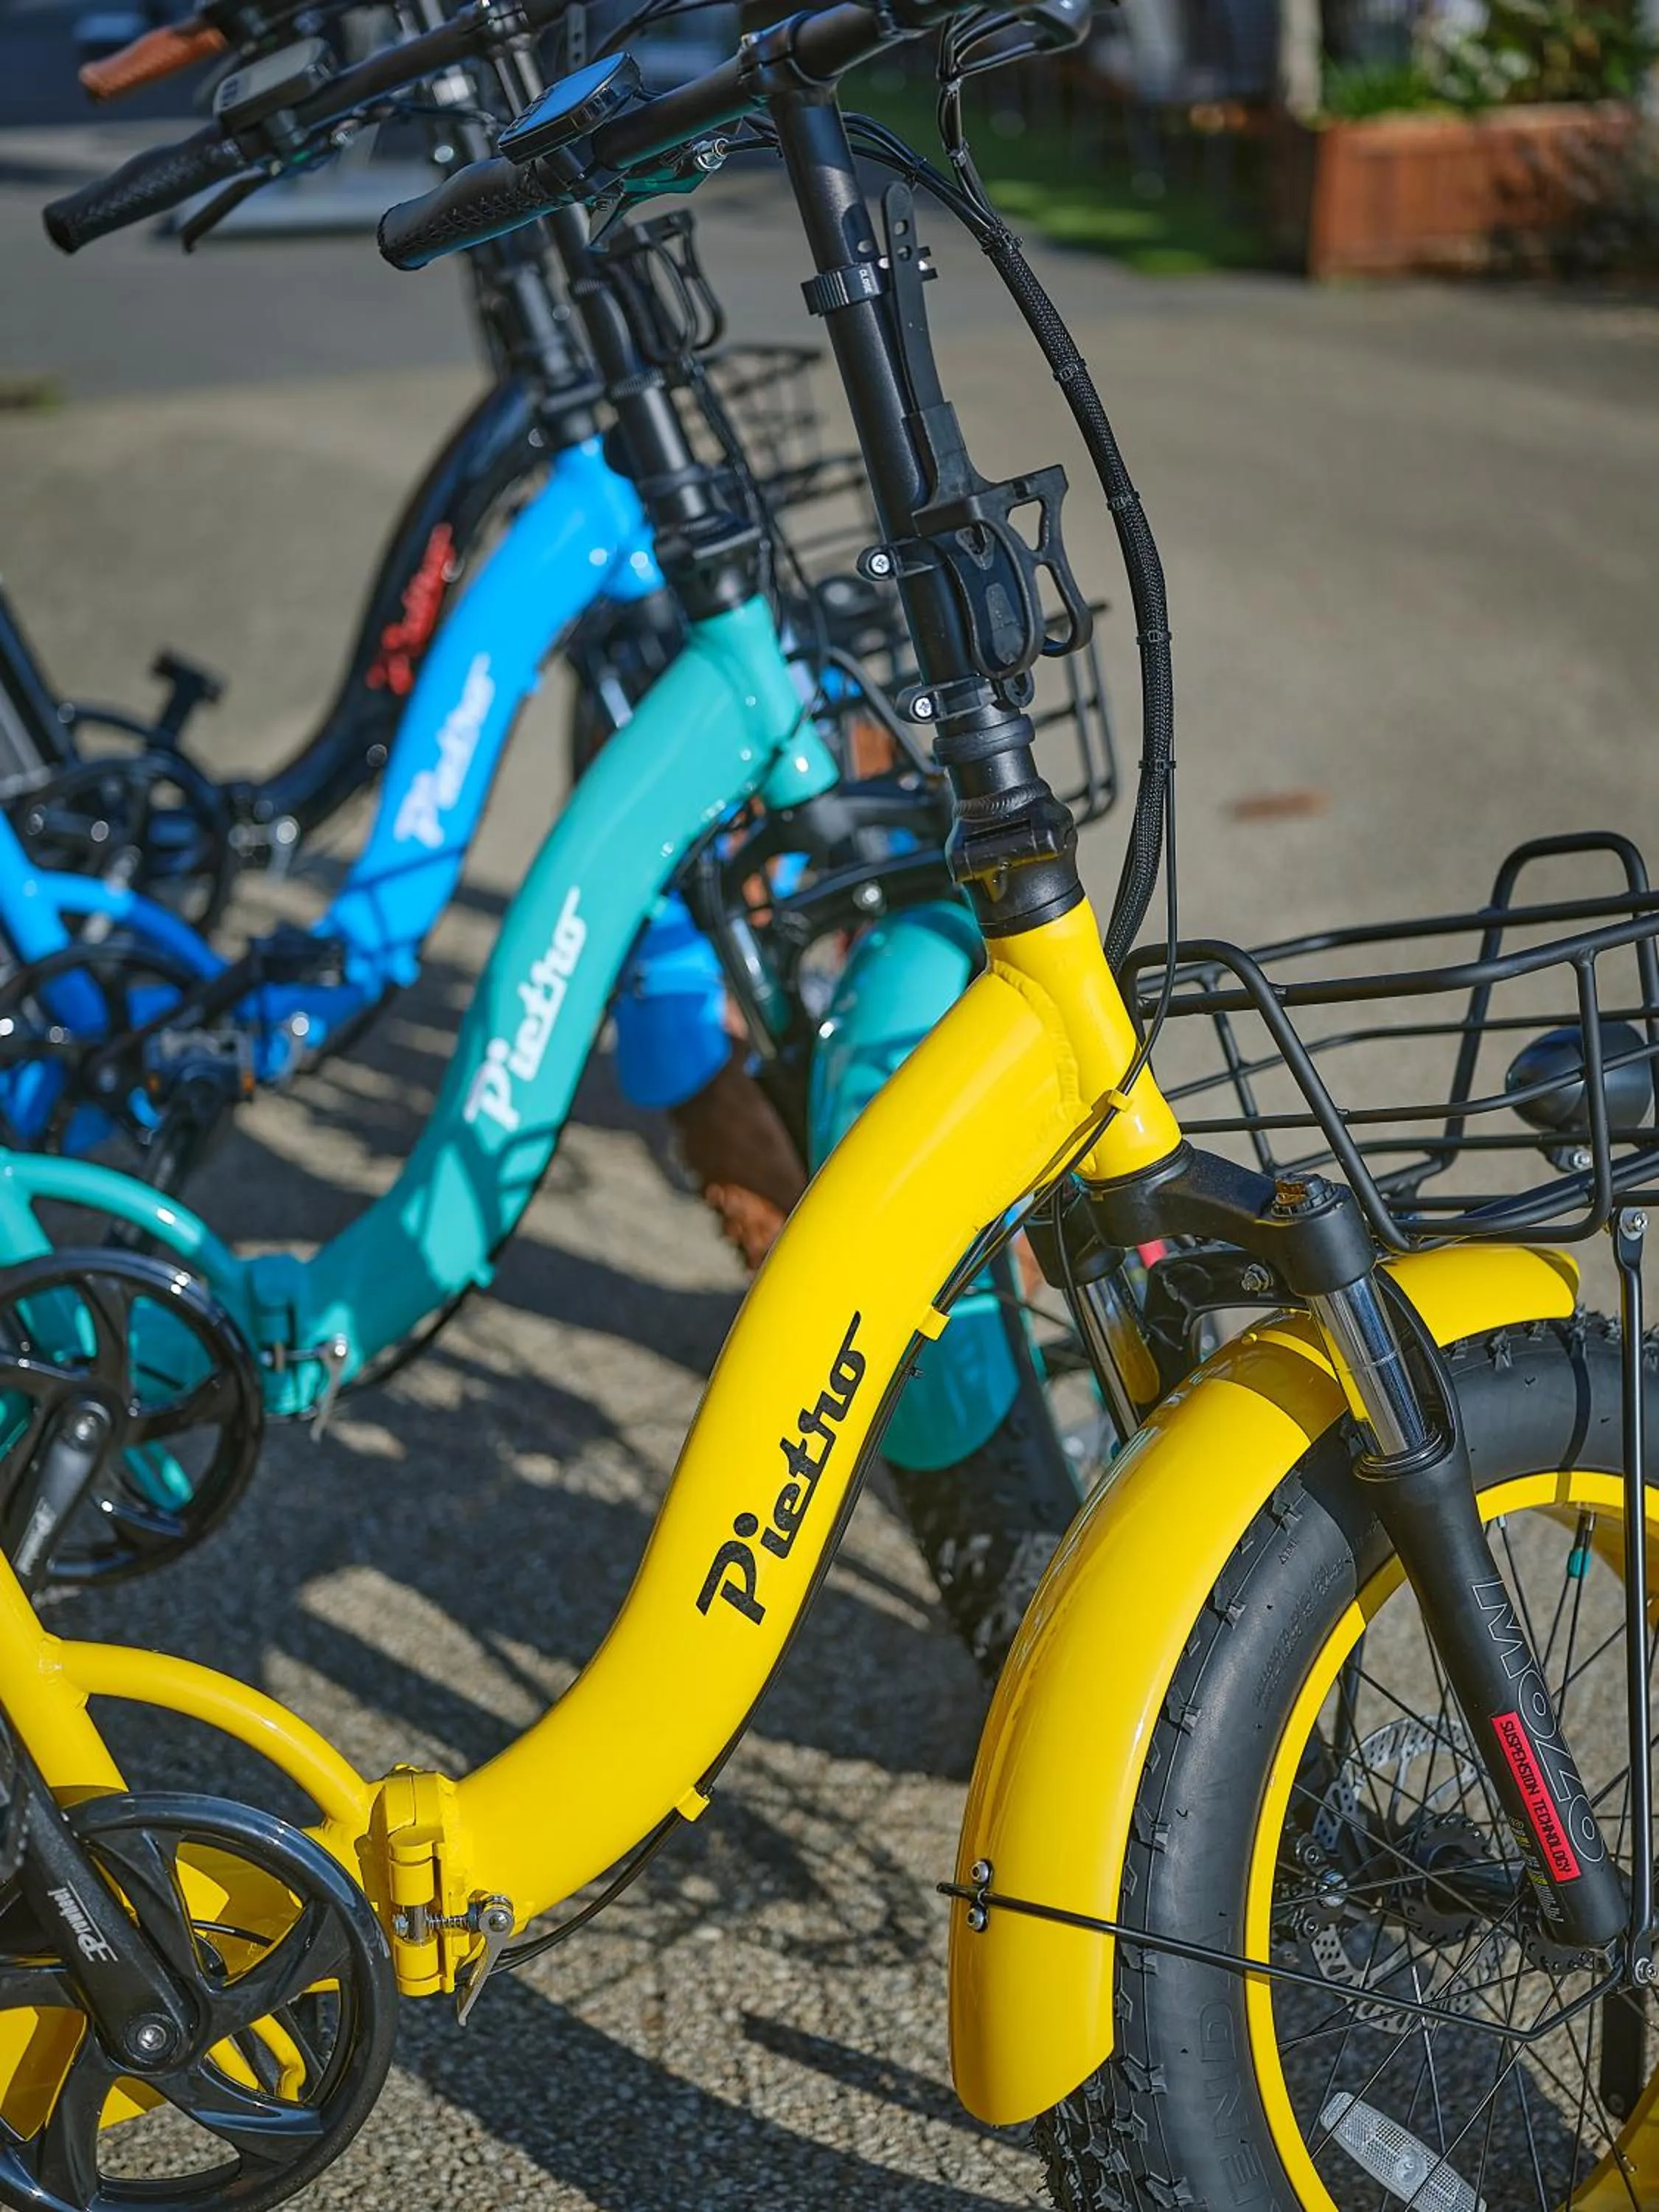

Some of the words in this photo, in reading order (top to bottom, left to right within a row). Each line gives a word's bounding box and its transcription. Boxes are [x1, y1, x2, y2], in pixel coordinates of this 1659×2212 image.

[463, 885, 588, 1132] Pietro
[696, 1310, 866, 1625] Pietro
[1499, 1719, 1540, 1795] SUSPENSION
[1533, 1797, 1573, 1873] TECHNOLOGY
[1183, 1926, 1281, 2212] ENDA
